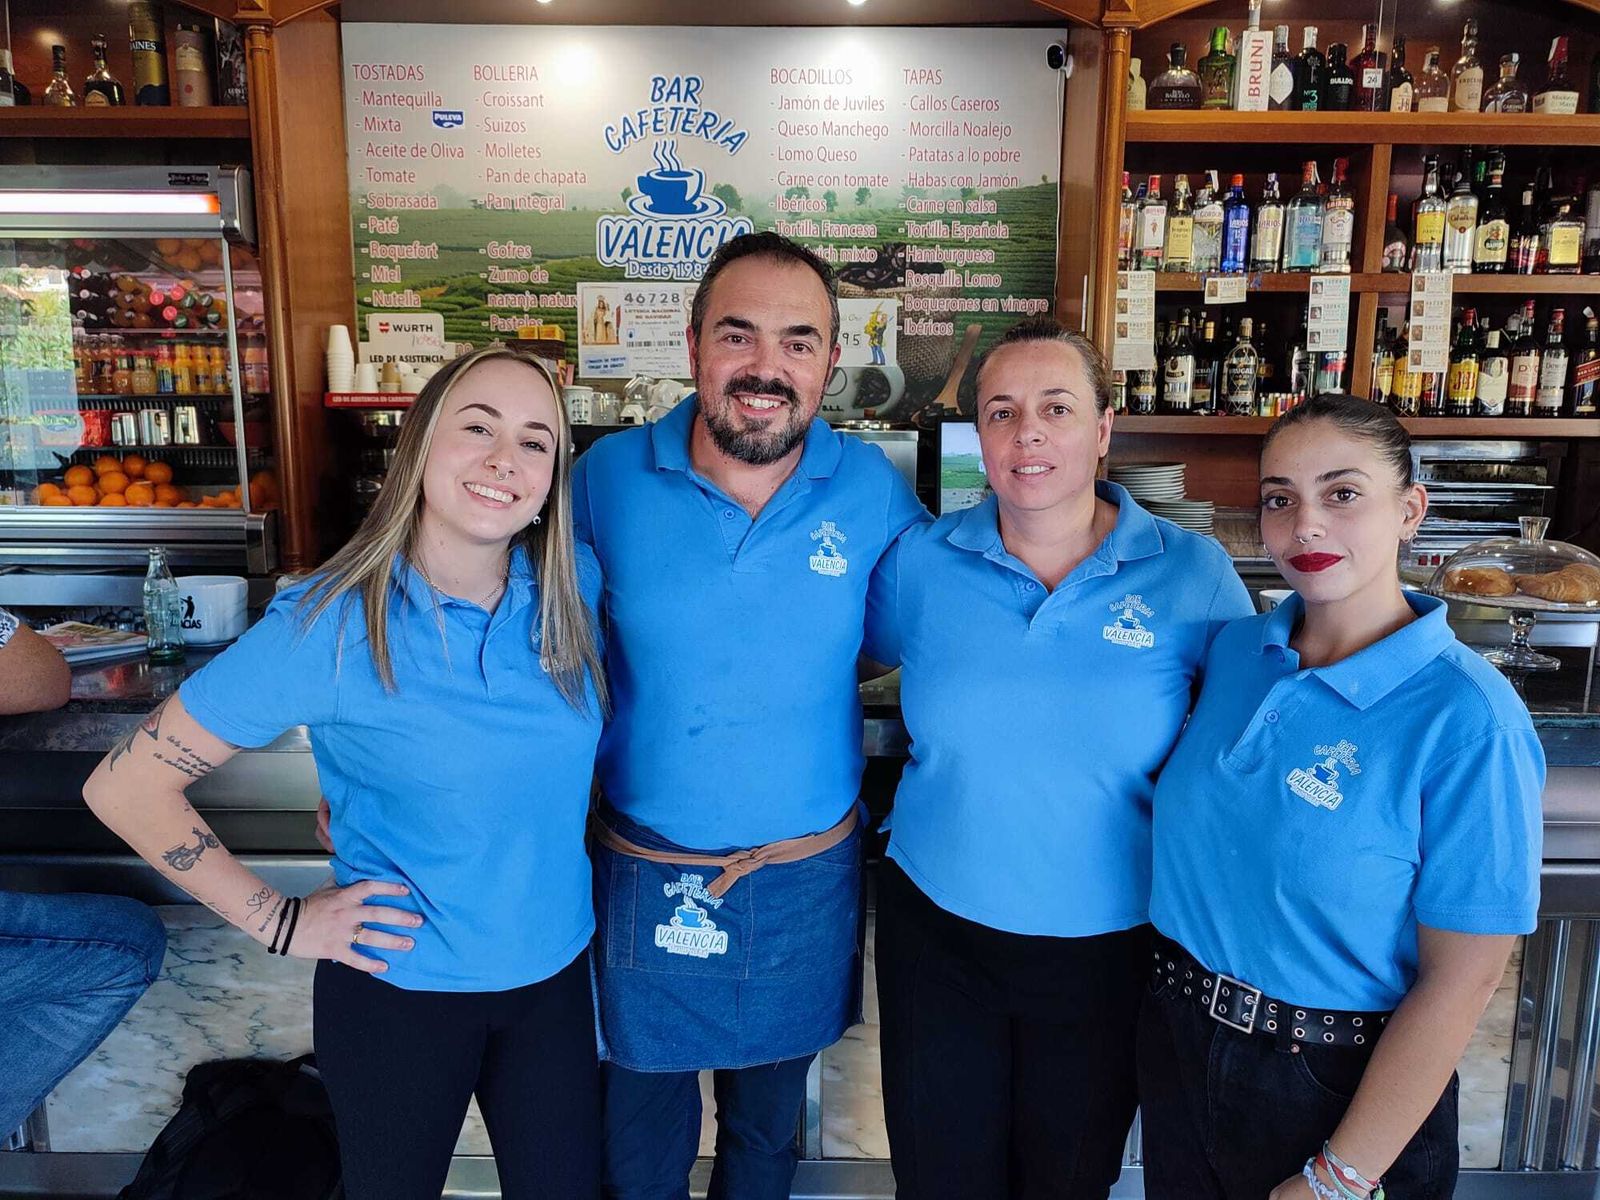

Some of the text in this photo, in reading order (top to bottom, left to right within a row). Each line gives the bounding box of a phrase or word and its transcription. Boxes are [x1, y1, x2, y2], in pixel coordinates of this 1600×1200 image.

[352, 64, 425, 81] TOSTADAS
[474, 64, 539, 81] BOLLERIA
[770, 68, 852, 85] BOCADILLOS
[1248, 39, 1264, 97] BRUNI
[903, 69, 943, 85] TAPAS
[483, 91, 544, 107] Croissant
[650, 76, 702, 105] BAR
[363, 91, 443, 110] Mantequilla
[778, 94, 885, 112] Jamón de Juviles
[910, 95, 1000, 112] Callos Caseros
[364, 117, 401, 132] Mixta
[484, 117, 527, 132] Suizos
[605, 106, 748, 154] CAFETERIA
[778, 121, 889, 141] Queso Manchego
[909, 121, 1012, 141] Morcilla Noalejo
[366, 143, 465, 158] Aceite de Oliva
[485, 143, 542, 158] Molletes
[778, 147, 857, 163] Lomo Queso
[909, 147, 1021, 166] Patatas a lo pobre
[366, 167, 416, 183] Tomate
[486, 168, 587, 187] Pan de chapata
[777, 171, 889, 187] Carne con tomate
[908, 172, 1018, 188] Habas con Jamón
[368, 193, 438, 209] Sobrasada
[487, 192, 565, 213] Pan integral
[777, 195, 827, 212] Ibéricos
[907, 196, 996, 213] Carne en salsa
[369, 216, 399, 234] Paté
[777, 220, 877, 238] Tortilla Francesa
[906, 220, 1009, 240] Tortilla Española
[487, 241, 532, 259] Gofres
[604, 225, 746, 260] VALENCI
[370, 241, 438, 262] Roquefort
[840, 245, 878, 262] mixto
[905, 244, 995, 264] Hamburguesa
[371, 266, 401, 283] Miel
[488, 266, 549, 283] Zumo de
[627, 262, 670, 278] Desde
[905, 270, 1002, 290] Rosquilla Lomo
[373, 290, 421, 308] Nutella
[488, 291, 577, 311] naranja natur
[624, 293, 680, 304] 46728
[904, 295, 1048, 316] Boquerones en vinagre
[490, 314, 543, 333] Pasteles
[904, 319, 954, 337] Ibéricos
[842, 332, 861, 346] 95
[399, 355, 445, 363] ASISTENCIA
[811, 559, 846, 570] VALENCIA
[1105, 628, 1152, 645] VALENCIA
[1289, 770, 1340, 807] VALENCIA
[681, 873, 704, 885] BAR
[659, 928, 725, 950] VALENCIA
